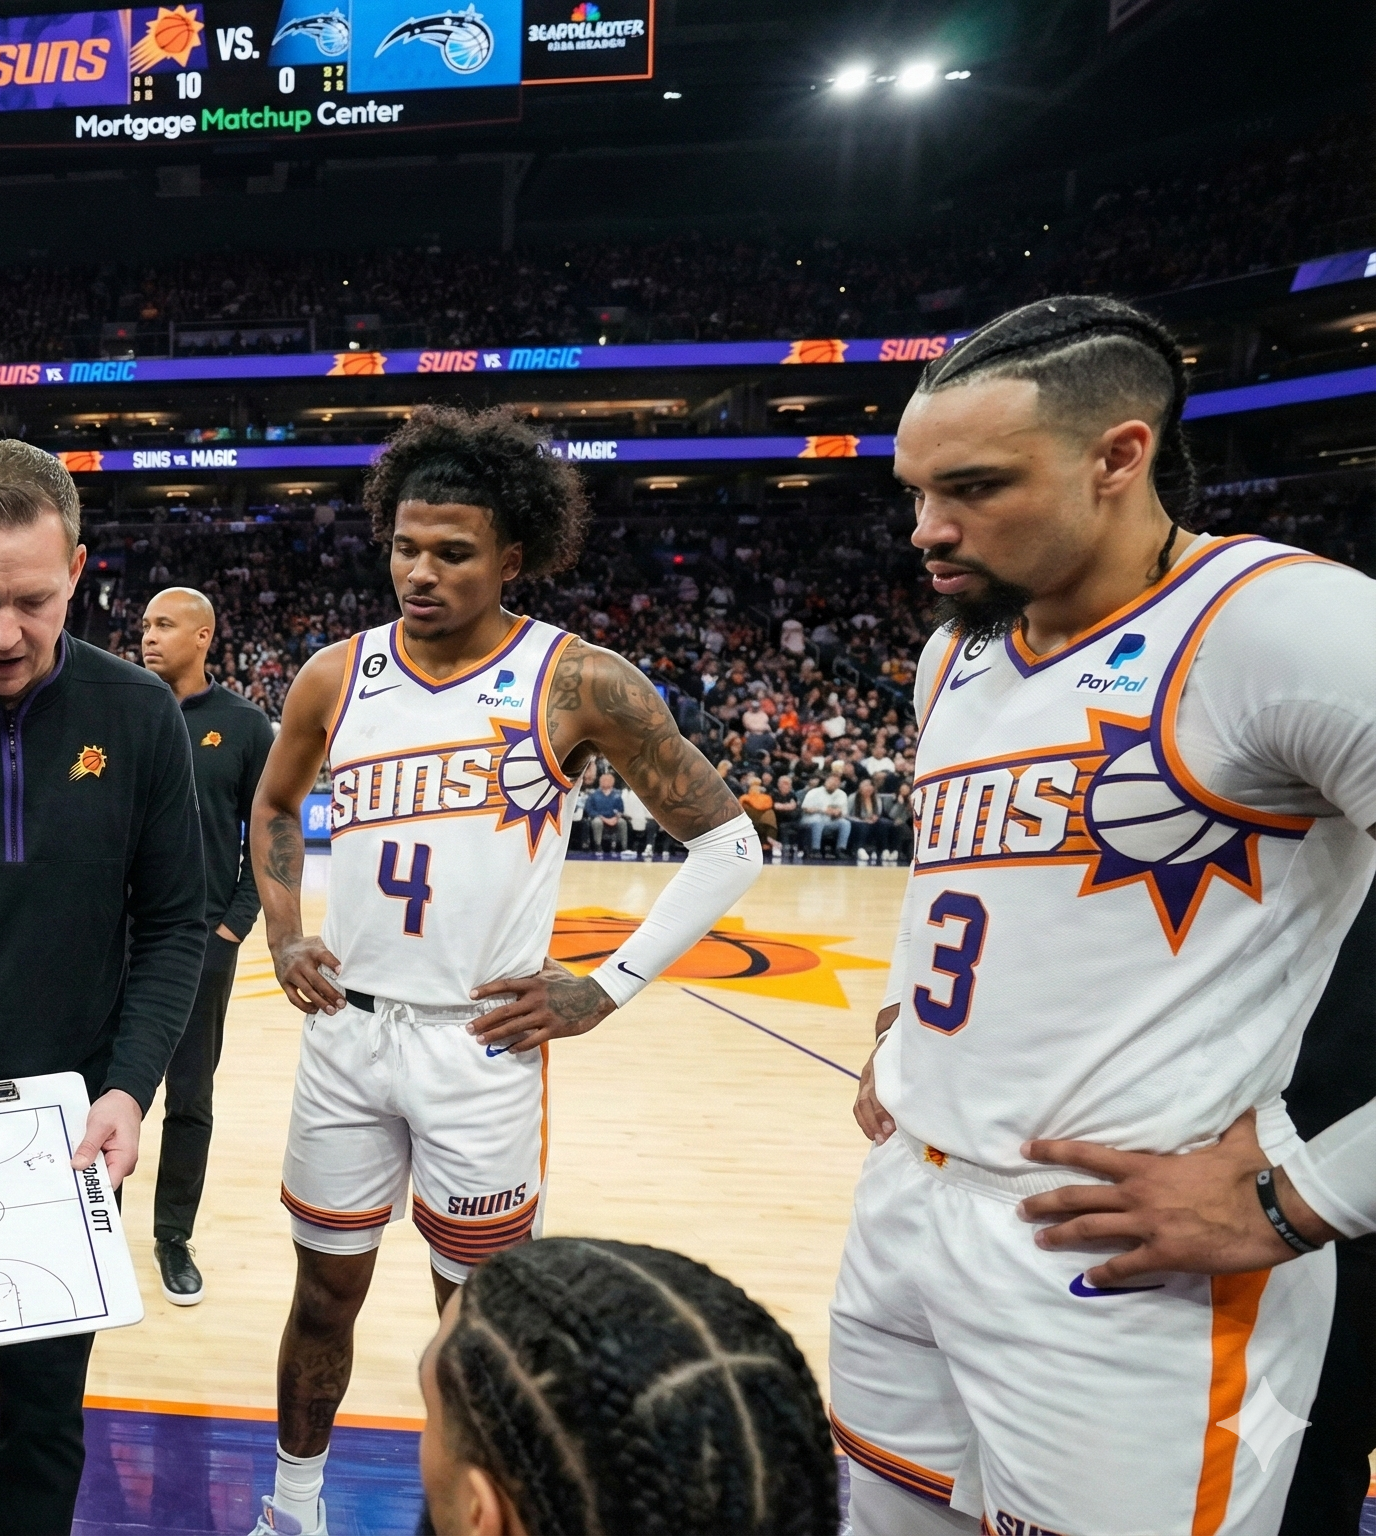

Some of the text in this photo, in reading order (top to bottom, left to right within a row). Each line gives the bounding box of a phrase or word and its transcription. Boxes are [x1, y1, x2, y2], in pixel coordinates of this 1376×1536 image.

[216, 26, 260, 61] VS.
[176, 72, 202, 99] 10
[279, 67, 295, 94] 0
[76, 100, 404, 141] Mortgage Matchup Center
[417, 351, 478, 372] SUNS
[508, 348, 582, 370] MAGIC
[879, 336, 947, 361] SUNS
[69, 361, 137, 383] MAGIC
[132, 451, 171, 468] SUNS
[191, 449, 237, 467] MAGIC
[367, 656, 382, 676] 6
[1076, 673, 1148, 693] PayPal
[477, 694, 524, 707] PayPal
[332, 748, 492, 829] SUNS
[377, 840, 432, 937] 4
[913, 890, 989, 1037] 3
[91, 1209, 112, 1233] OTT
